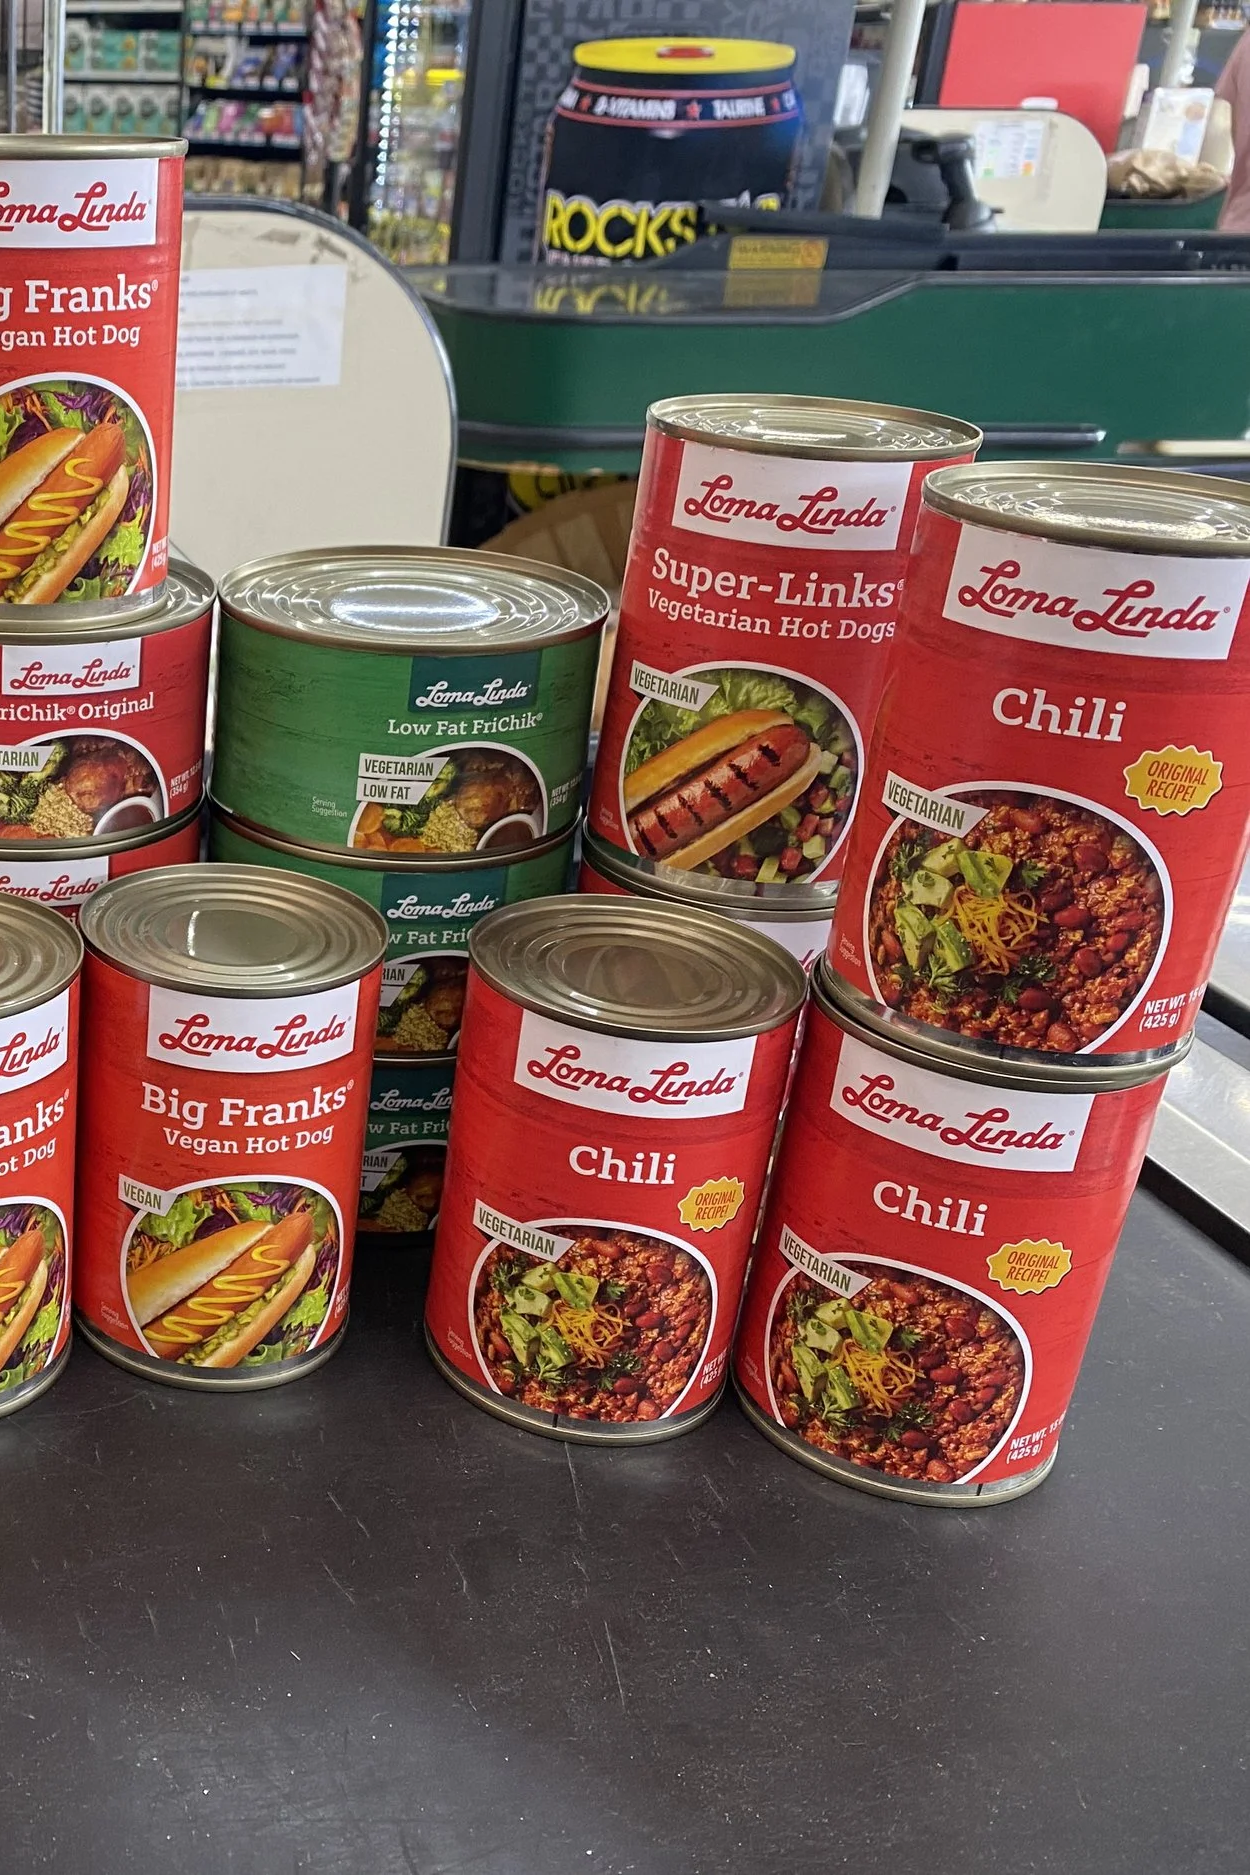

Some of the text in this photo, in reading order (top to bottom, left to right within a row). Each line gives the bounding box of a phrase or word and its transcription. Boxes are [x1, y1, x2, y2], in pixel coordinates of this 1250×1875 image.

[58, 182, 147, 232] Linda
[53, 326, 97, 346] Hot
[103, 325, 140, 348] Dog
[684, 474, 889, 535] Loma Linda
[958, 560, 1222, 638] Loma Linda
[648, 588, 895, 643] Vegetarian Hot Dogs
[10, 658, 131, 689] Loma Linda
[634, 668, 699, 704] VEGETARIAN
[78, 692, 154, 720] Original
[416, 678, 528, 707] Loma Linda
[388, 719, 429, 736] Low
[436, 721, 468, 736] Fat
[992, 688, 1127, 742] Chili
[364, 759, 434, 776] VEGETARIAN
[1147, 760, 1208, 785] ORIGINAL
[363, 785, 411, 799] LOW FAT
[888, 779, 966, 830] VEGETARIAN
[1145, 779, 1195, 802] RECIPE!
[39, 875, 98, 901] Linda
[387, 892, 495, 919] Loma Linda
[407, 931, 437, 945] Fat
[1144, 999, 1168, 1014] NET
[1169, 993, 1186, 1010] WT.
[158, 1014, 346, 1059] Loma Linda
[1139, 1013, 1169, 1032] (425
[527, 1045, 734, 1106] Loma Linda
[141, 1081, 207, 1131] Big
[423, 1087, 453, 1110] Lin
[390, 1122, 419, 1135] Fat
[842, 1074, 1063, 1155] Loma Linda
[23, 1138, 57, 1167] Dog
[163, 1124, 334, 1155] Vegan Hot Dog
[569, 1145, 676, 1185] Chili
[123, 1180, 162, 1211] VEGAN
[695, 1189, 736, 1207] ORIGINAL
[873, 1180, 988, 1237] Chili
[695, 1205, 728, 1221] RECIPE!
[479, 1207, 556, 1257] VEGETARIAN
[784, 1233, 852, 1292] VEGETARIAN
[1007, 1250, 1060, 1270] ORIGINAL
[1006, 1267, 1050, 1284] RECIPE!
[1006, 1445, 1032, 1465] (425
[1010, 1435, 1032, 1450] NET
